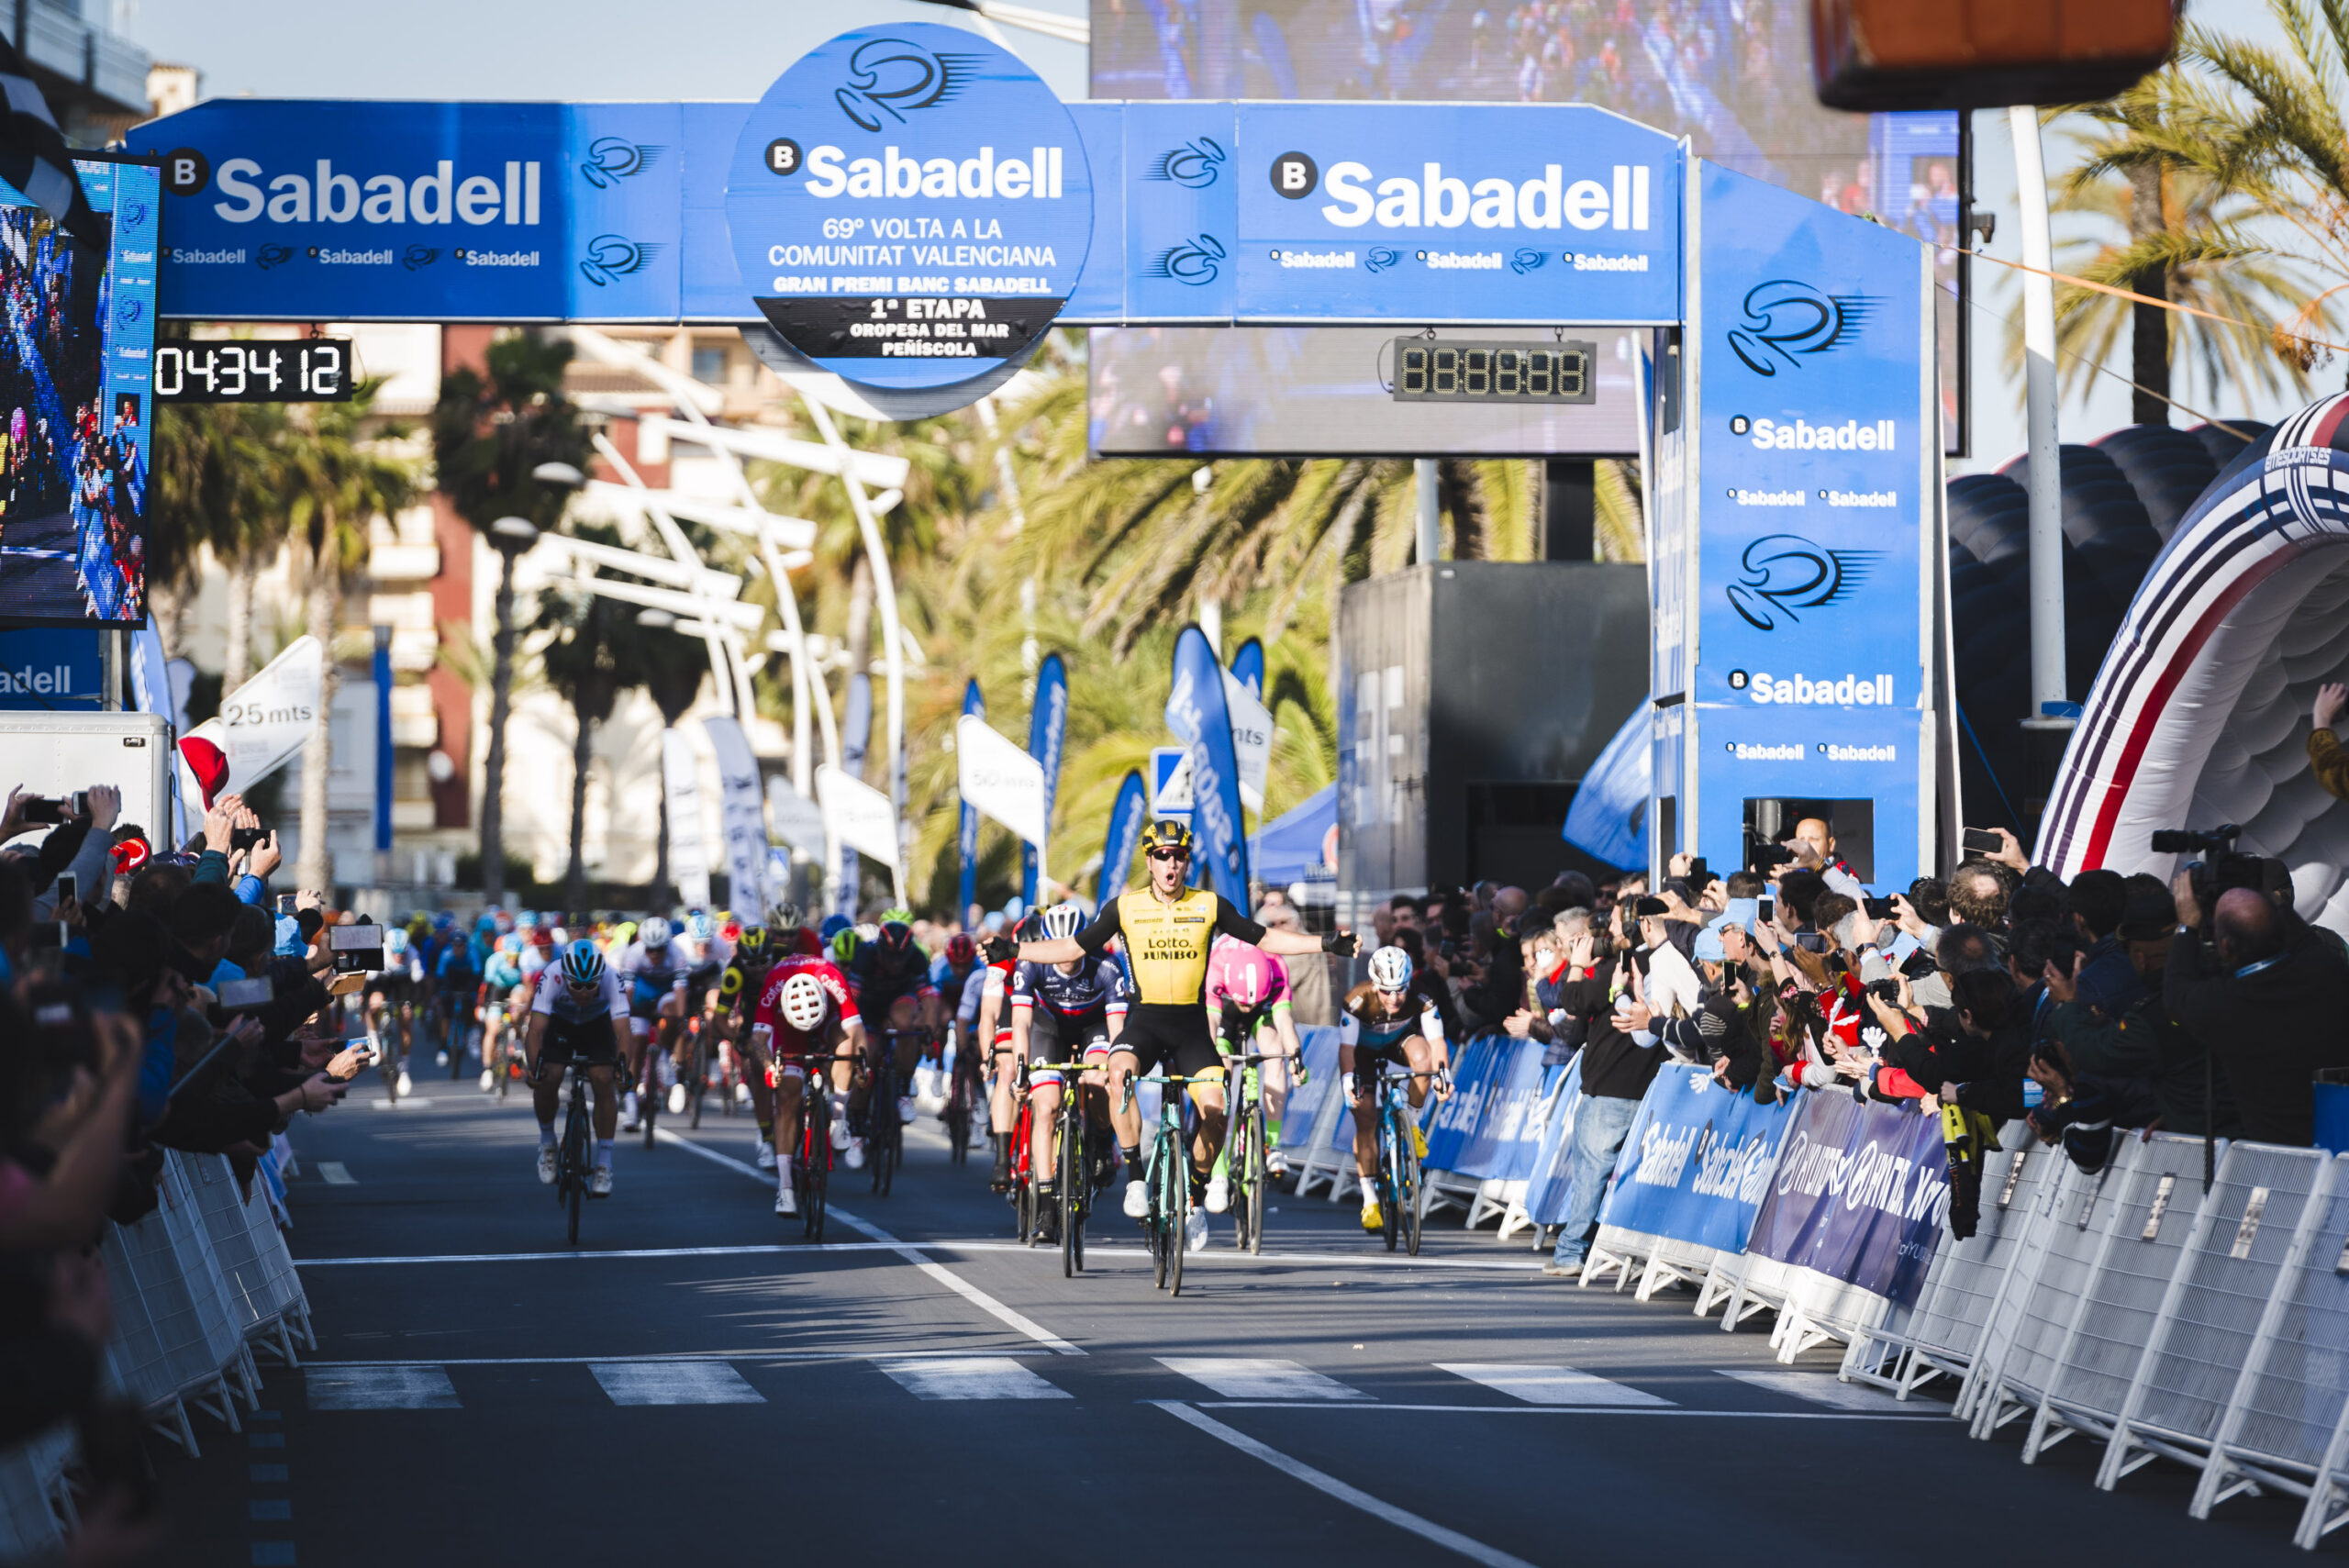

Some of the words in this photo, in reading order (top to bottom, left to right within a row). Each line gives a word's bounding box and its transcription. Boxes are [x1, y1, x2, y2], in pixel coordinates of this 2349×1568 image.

[774, 146, 795, 169] B
[804, 146, 1063, 199] Sabadell
[174, 159, 196, 184] B
[214, 158, 540, 226] Sabadell
[1283, 162, 1307, 189] B
[1321, 161, 1649, 230] Sabadell
[871, 218, 944, 239] VOLTA
[952, 218, 968, 239] A
[974, 218, 1002, 239] LA
[173, 249, 246, 263] Sabadell
[319, 249, 394, 264] Sabadell
[466, 250, 540, 266] Sabadell
[768, 245, 904, 266] COMUNITAT
[911, 245, 1056, 266] VALENCIANA
[1280, 251, 1355, 269] Sabadell
[1427, 251, 1503, 270] Sabadell
[1574, 253, 1649, 272] Sabadell
[773, 276, 826, 293] GRAN
[832, 276, 892, 293] PREMI
[897, 276, 948, 293] BANC
[954, 276, 1052, 294] SABADELL
[907, 299, 985, 319] ETAPA
[850, 323, 932, 339] OROPESA
[936, 323, 965, 338] DEL
[970, 323, 1009, 338] MAR
[1752, 418, 1895, 450] Sabadell
[1737, 490, 1805, 506] Sabadell
[1828, 491, 1897, 507] Sabadell
[1750, 673, 1893, 706] Sabadell
[228, 703, 263, 727] 25
[269, 705, 313, 724] mts
[1736, 744, 1804, 761] Sabadell
[1827, 745, 1896, 762] Sabadell
[1142, 951, 1198, 961] JUMBO
